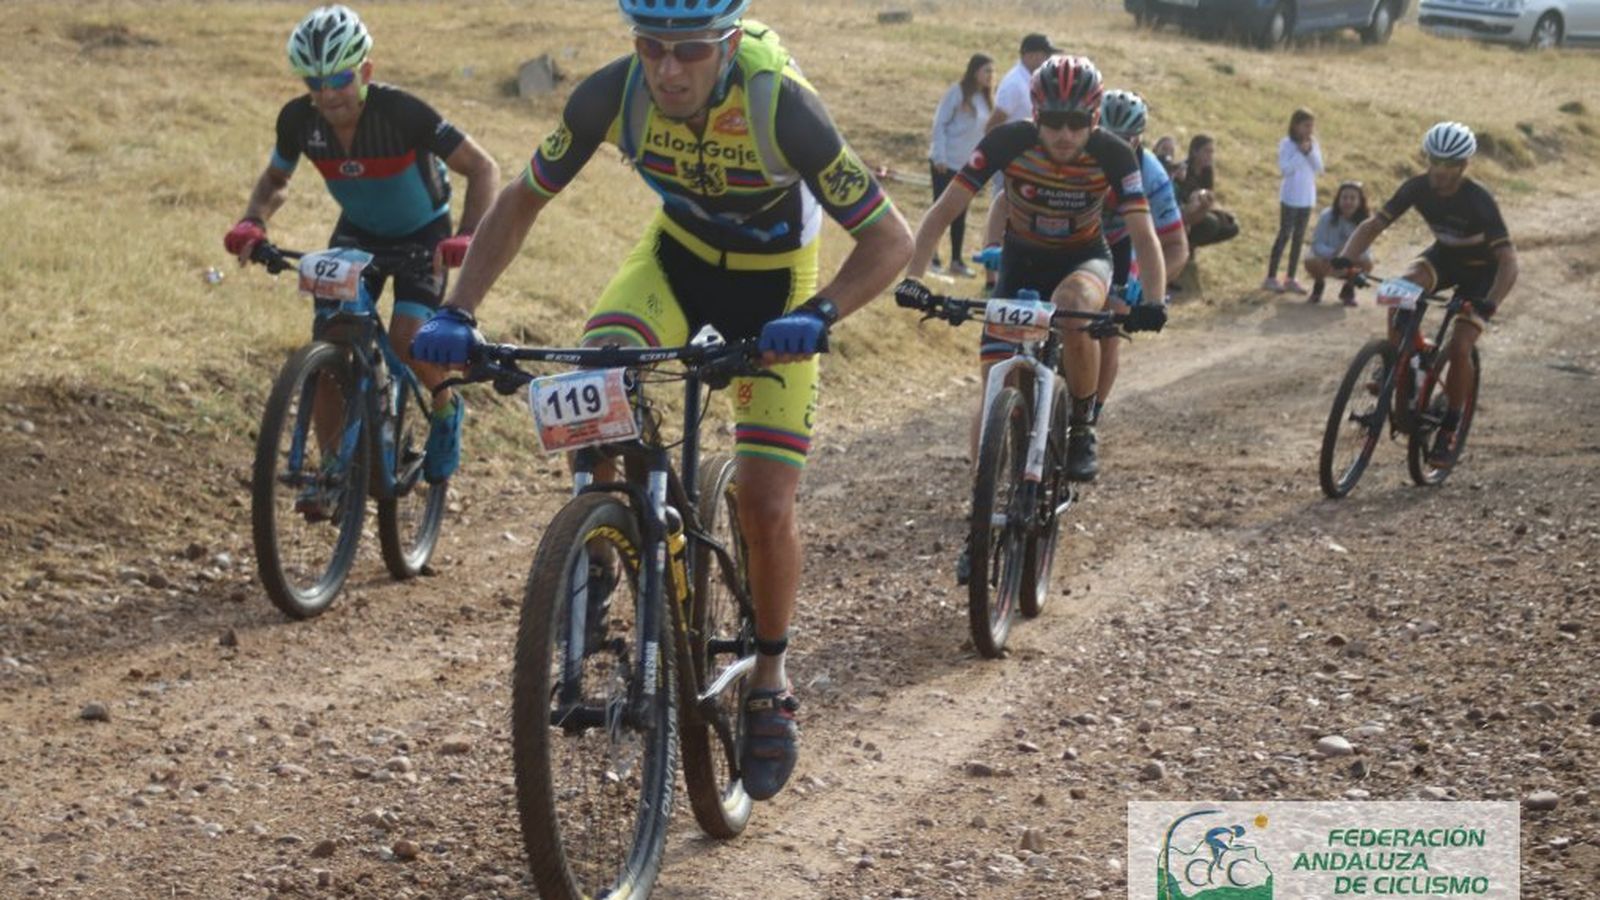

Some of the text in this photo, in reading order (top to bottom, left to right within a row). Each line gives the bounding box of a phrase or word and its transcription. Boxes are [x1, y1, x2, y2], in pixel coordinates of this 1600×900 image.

[646, 127, 699, 154] iclos
[315, 259, 340, 278] 62
[998, 306, 1034, 325] 142
[547, 384, 602, 419] 119
